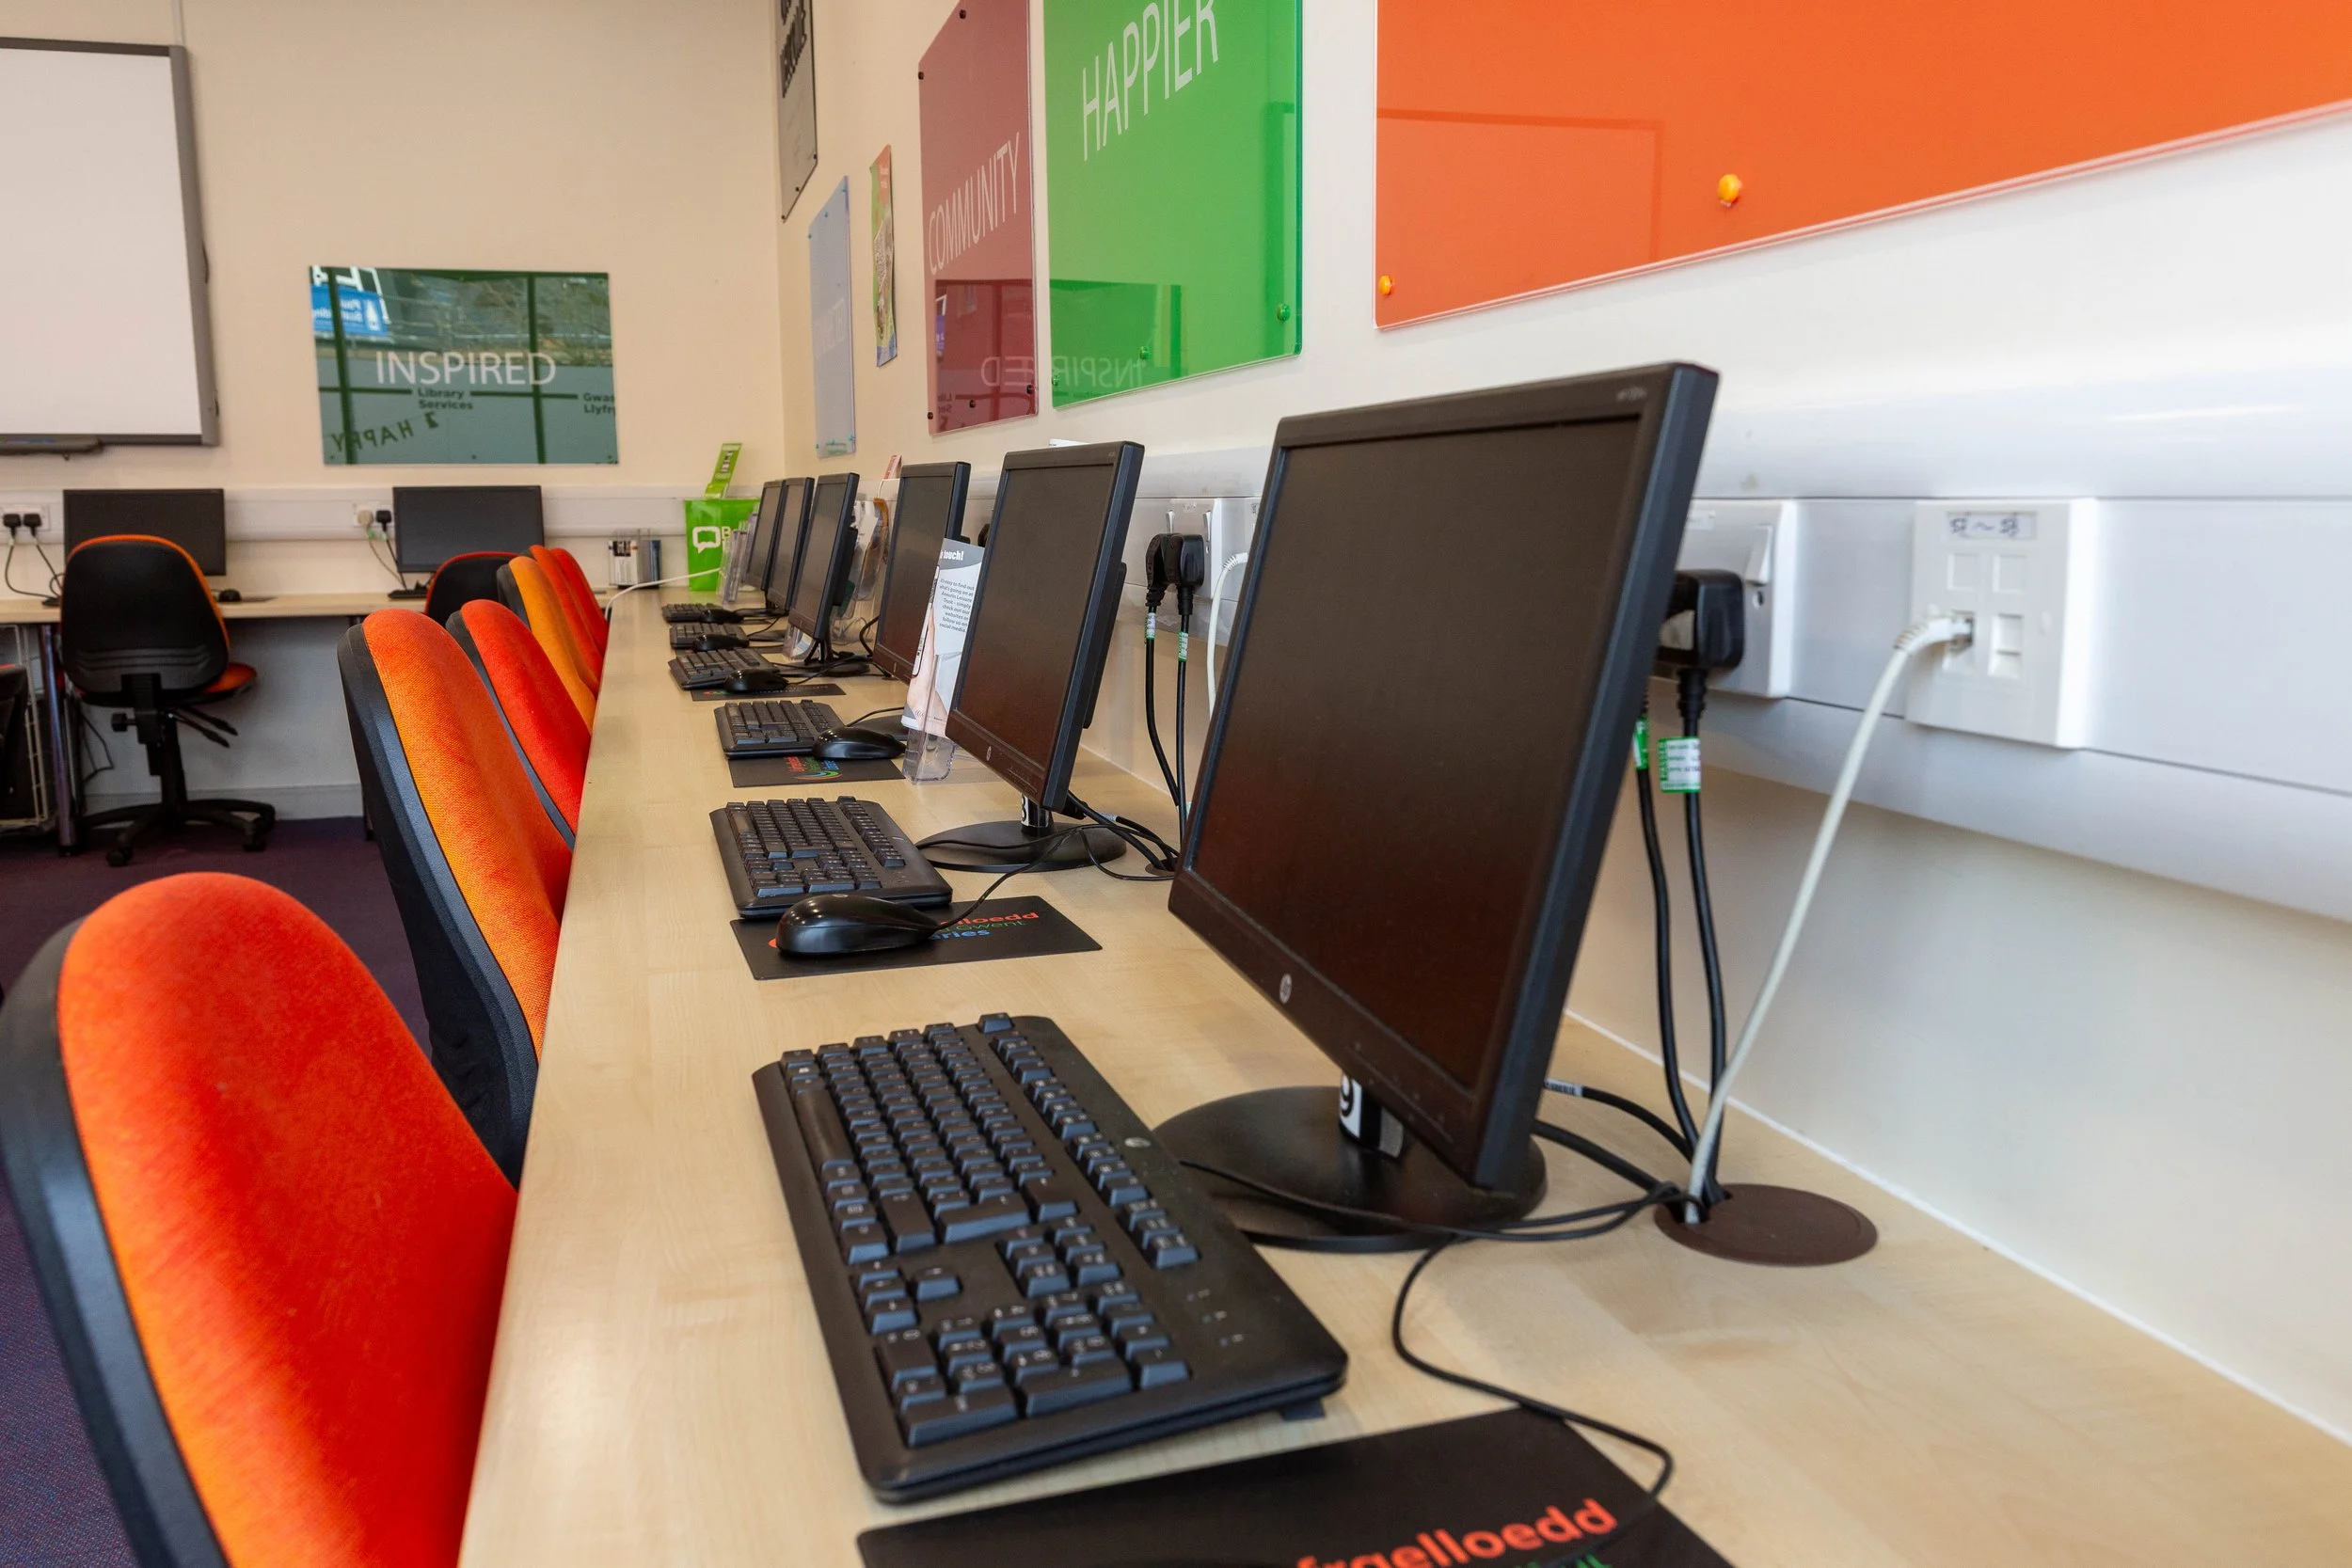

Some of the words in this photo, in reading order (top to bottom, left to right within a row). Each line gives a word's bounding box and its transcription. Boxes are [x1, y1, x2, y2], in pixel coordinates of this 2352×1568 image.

[1083, 0, 1219, 162] HAPPIER
[929, 132, 1020, 275] COMMUNITY
[376, 351, 556, 386] INSPIRED
[418, 388, 464, 400] Library
[419, 399, 473, 410] Services
